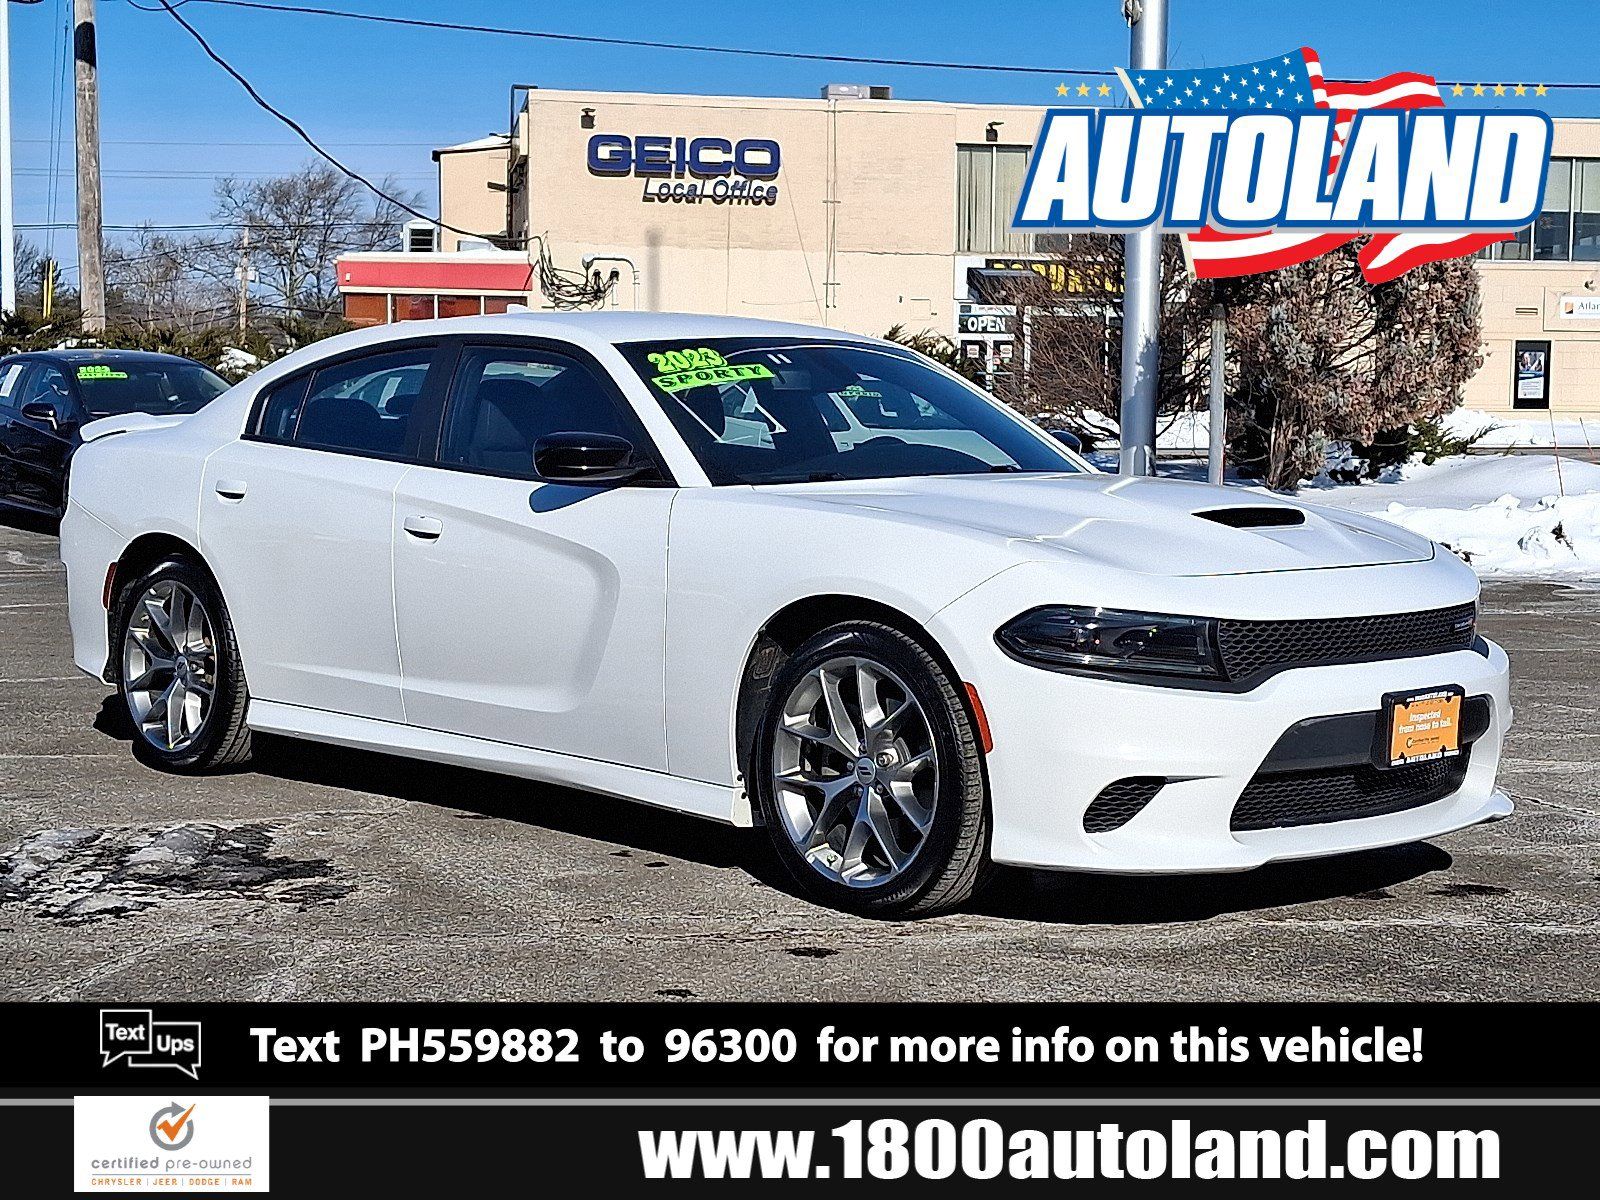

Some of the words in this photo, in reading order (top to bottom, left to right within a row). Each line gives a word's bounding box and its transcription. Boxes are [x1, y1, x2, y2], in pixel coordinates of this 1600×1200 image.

[587, 134, 781, 180] GEICO
[642, 176, 705, 203] Local
[711, 178, 779, 205] Office
[967, 316, 1006, 332] OPEN
[647, 347, 728, 374] 2023
[658, 365, 763, 388] SPORTY
